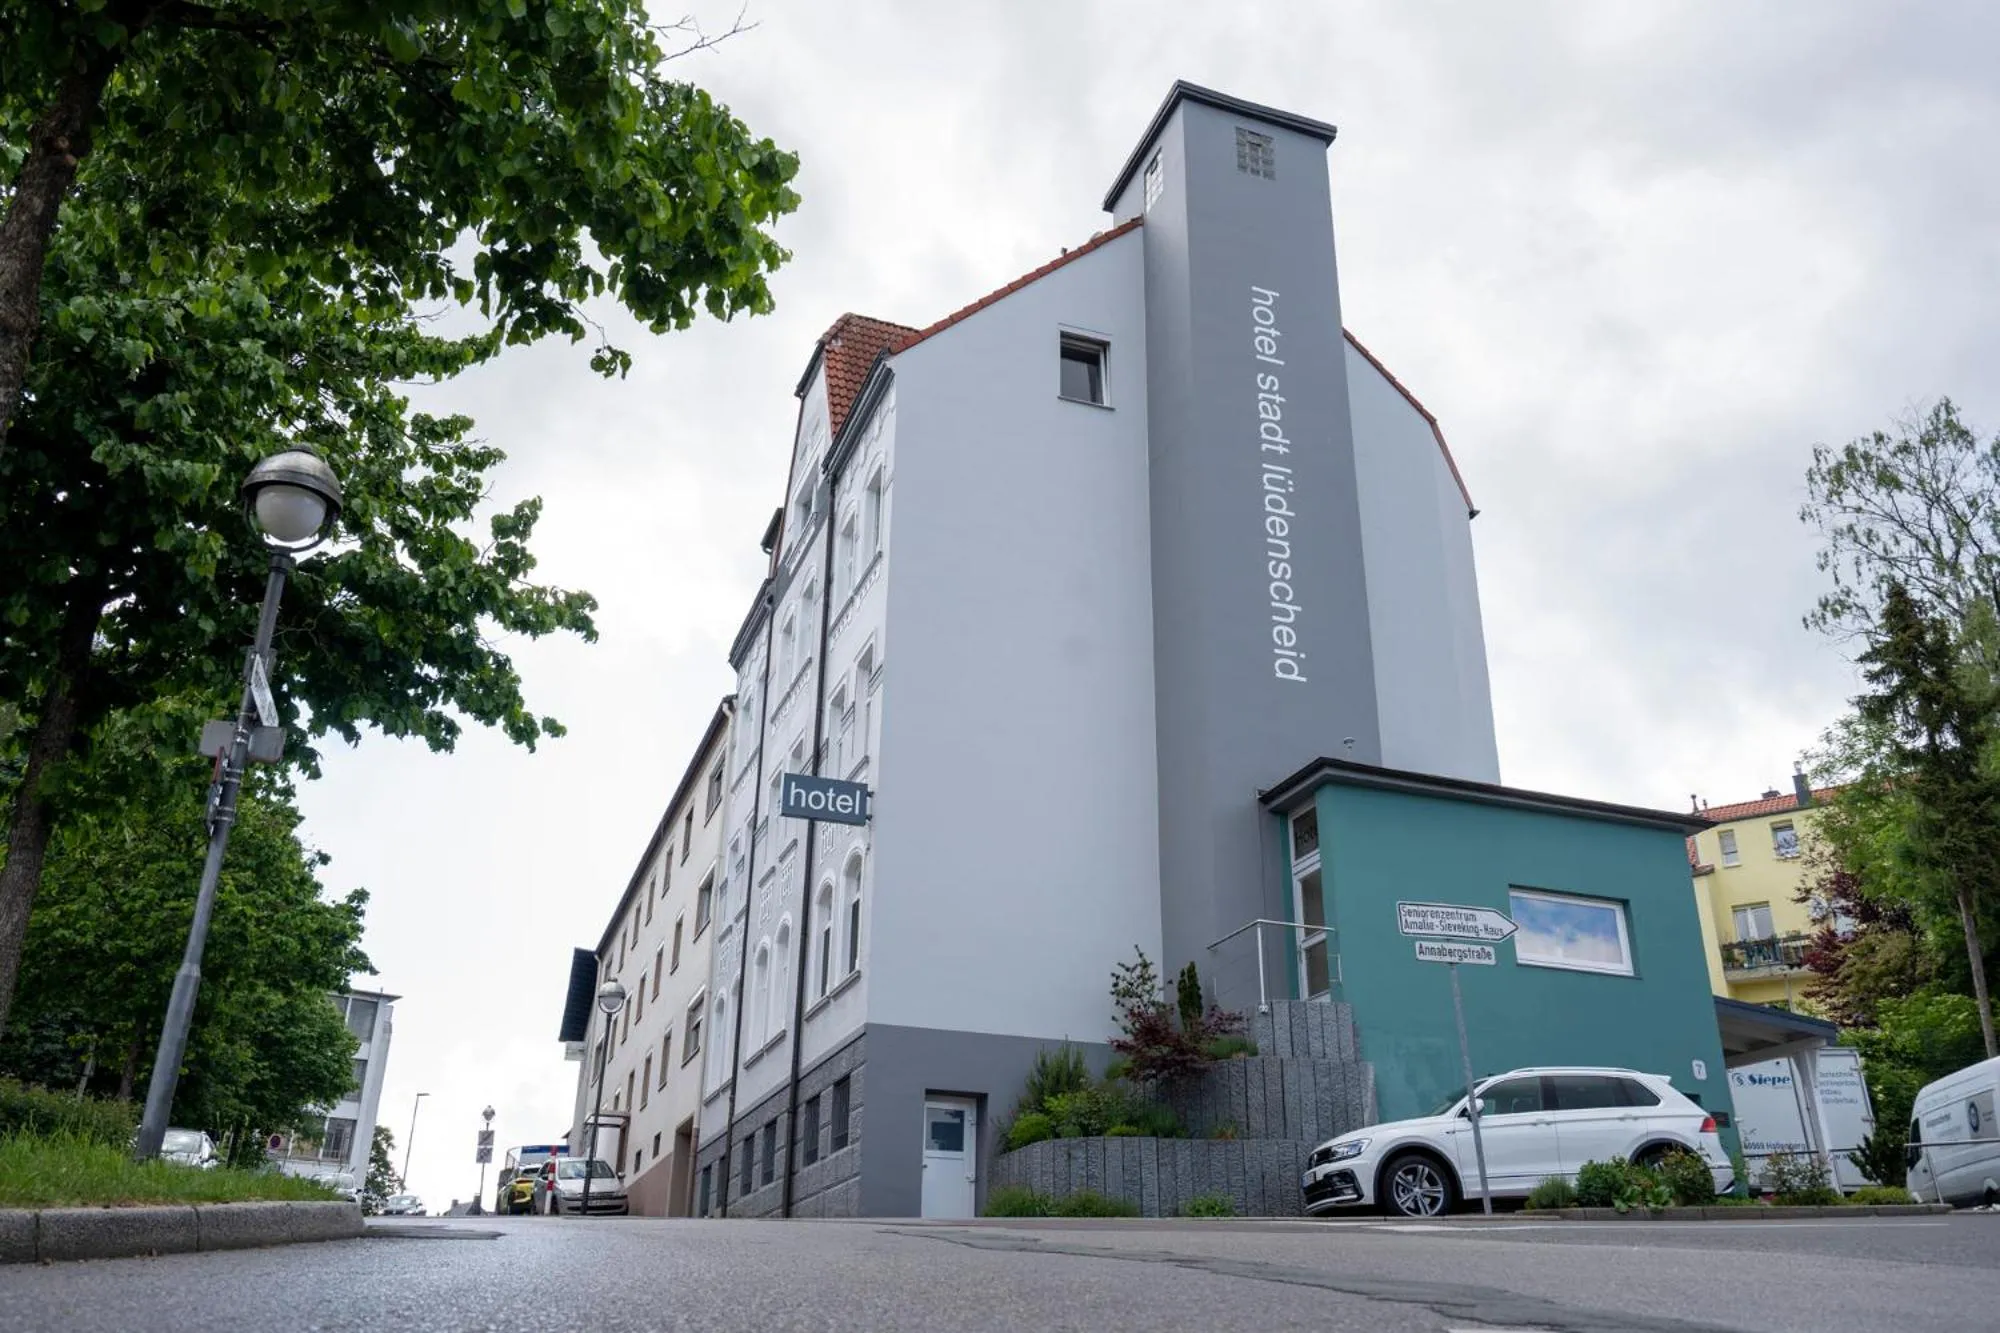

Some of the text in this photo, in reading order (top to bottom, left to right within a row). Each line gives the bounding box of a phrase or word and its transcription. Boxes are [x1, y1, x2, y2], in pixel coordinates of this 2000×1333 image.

[1251, 284, 1308, 683] hotel stadt lüdenscheid
[789, 781, 861, 816] hotel
[1401, 906, 1477, 922] Seniorenzentrum
[1418, 943, 1492, 960] Annabergstraße
